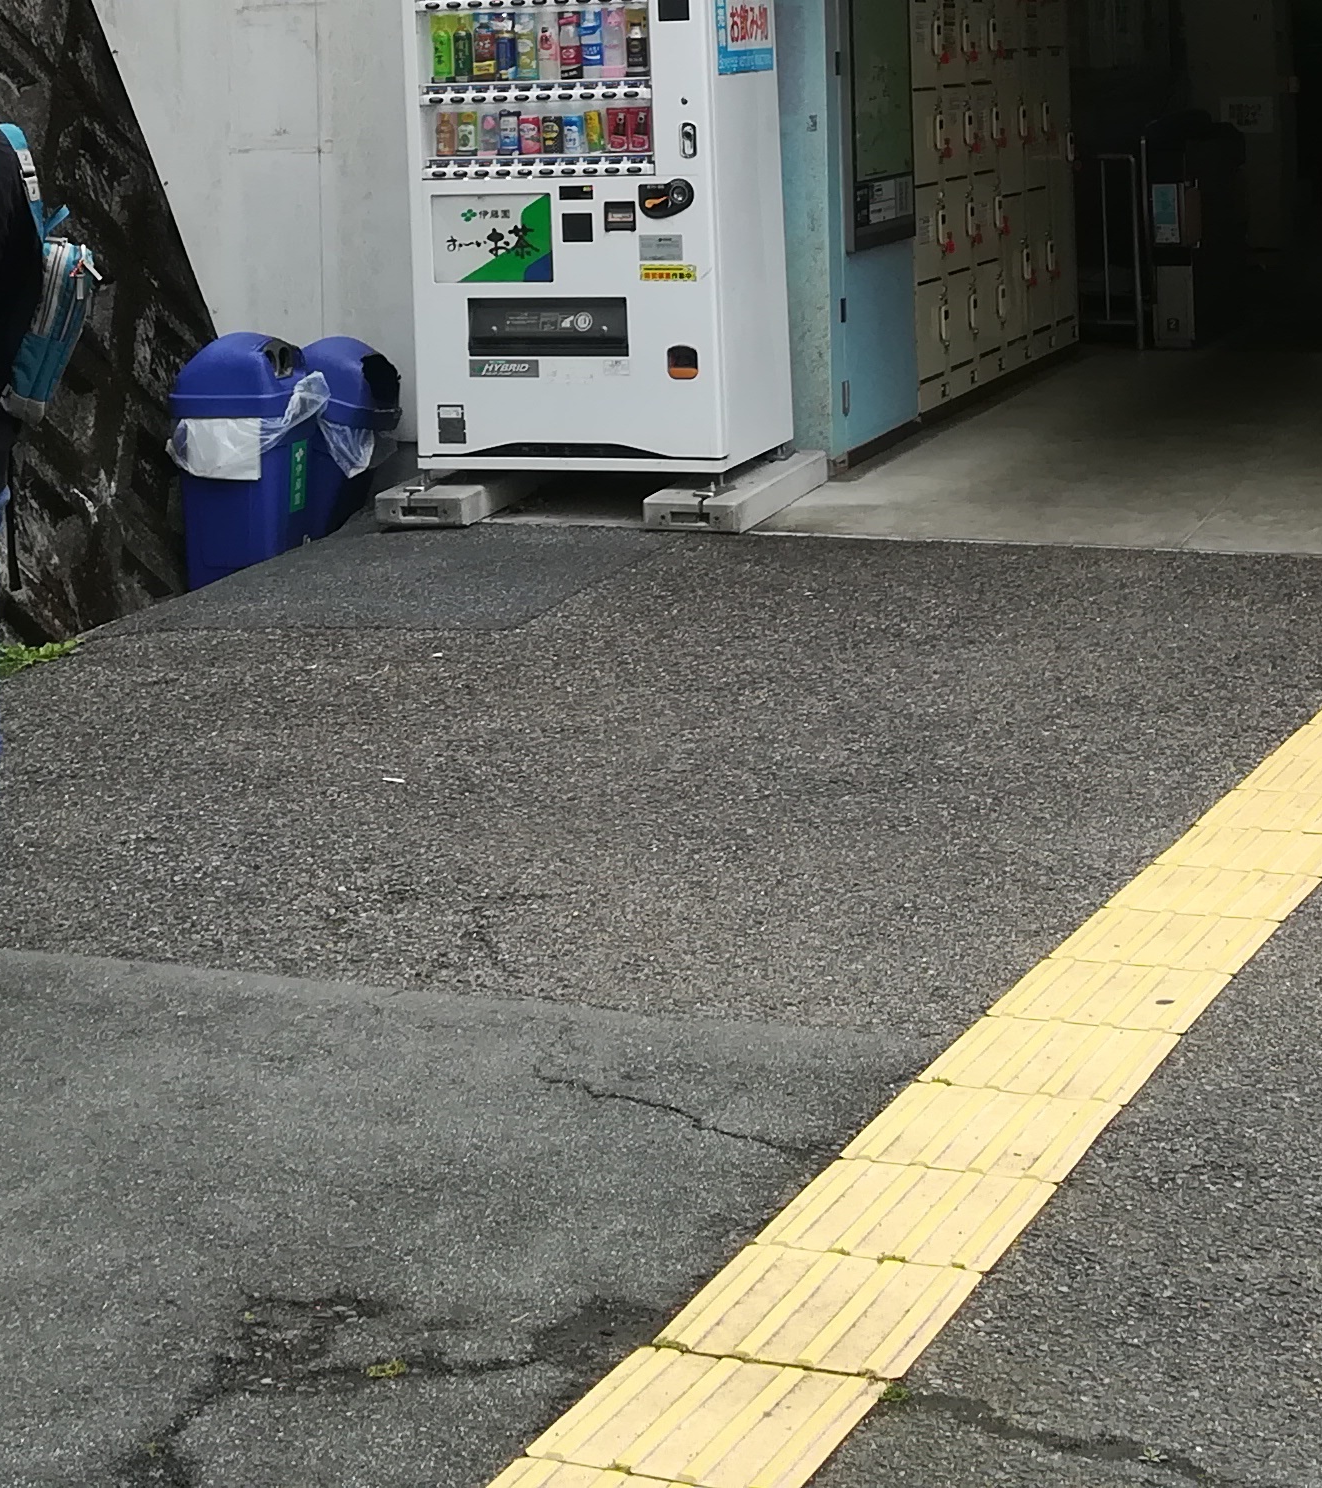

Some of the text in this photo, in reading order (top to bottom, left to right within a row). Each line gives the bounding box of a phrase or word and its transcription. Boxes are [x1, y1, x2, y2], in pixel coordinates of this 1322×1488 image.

[730, 4, 768, 43] お飲み物
[479, 210, 510, 219] 伊藤園
[481, 363, 530, 375] HYBRID
